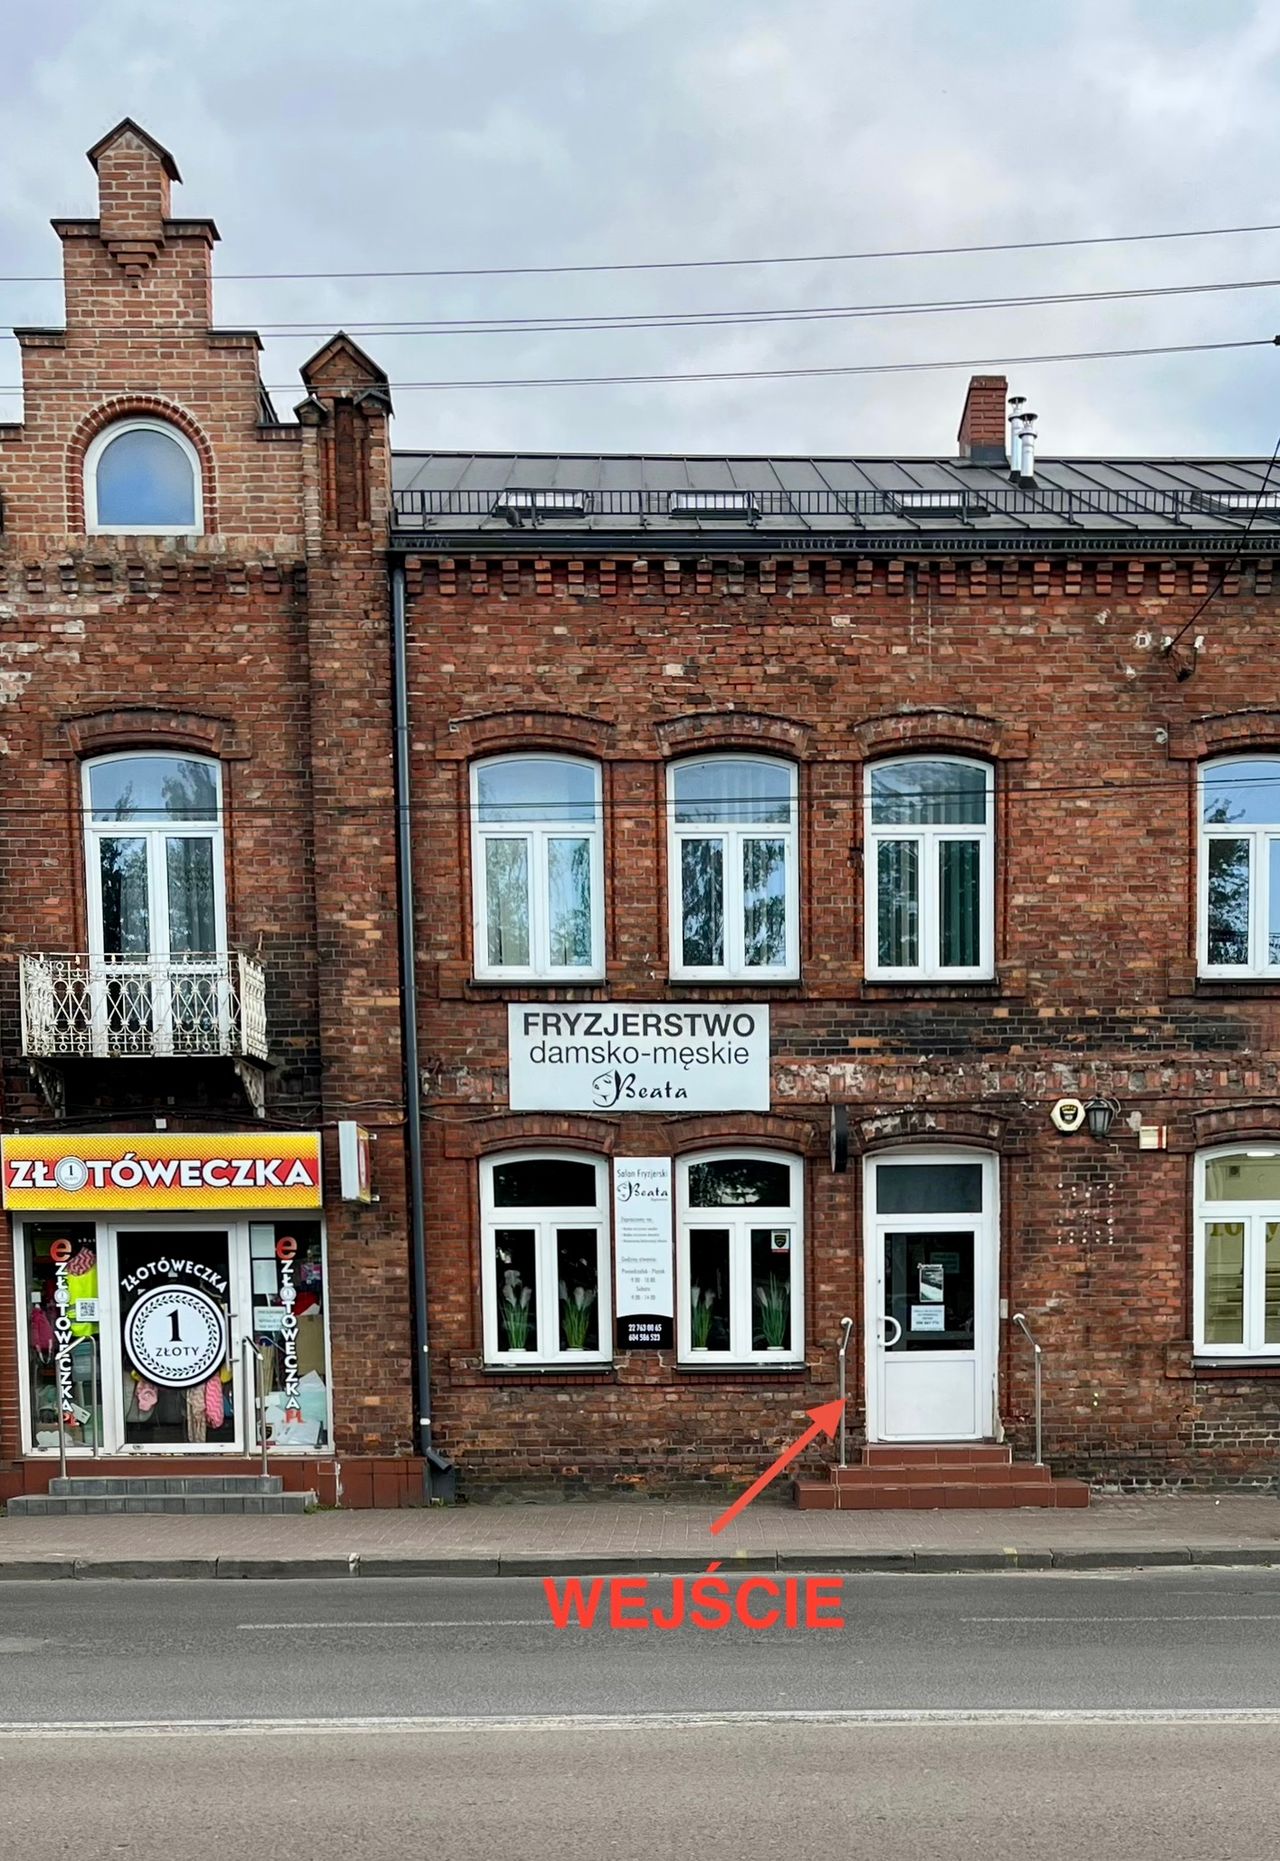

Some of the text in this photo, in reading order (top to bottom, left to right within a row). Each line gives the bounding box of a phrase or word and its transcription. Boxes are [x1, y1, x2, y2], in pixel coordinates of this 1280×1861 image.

[523, 1012, 756, 1037] FRYZJERSTWO
[529, 1040, 750, 1071] damsko-męskie
[615, 1069, 688, 1099] Beata
[8, 1152, 314, 1190] ZŁOTÓWECZKA
[617, 1168, 668, 1180] Salon Fryzjerski
[628, 1180, 668, 1201] Beata
[121, 1256, 228, 1293] ZŁOTÓWECZKA
[166, 1308, 183, 1342] 1
[155, 1346, 200, 1357] ZŁOTY
